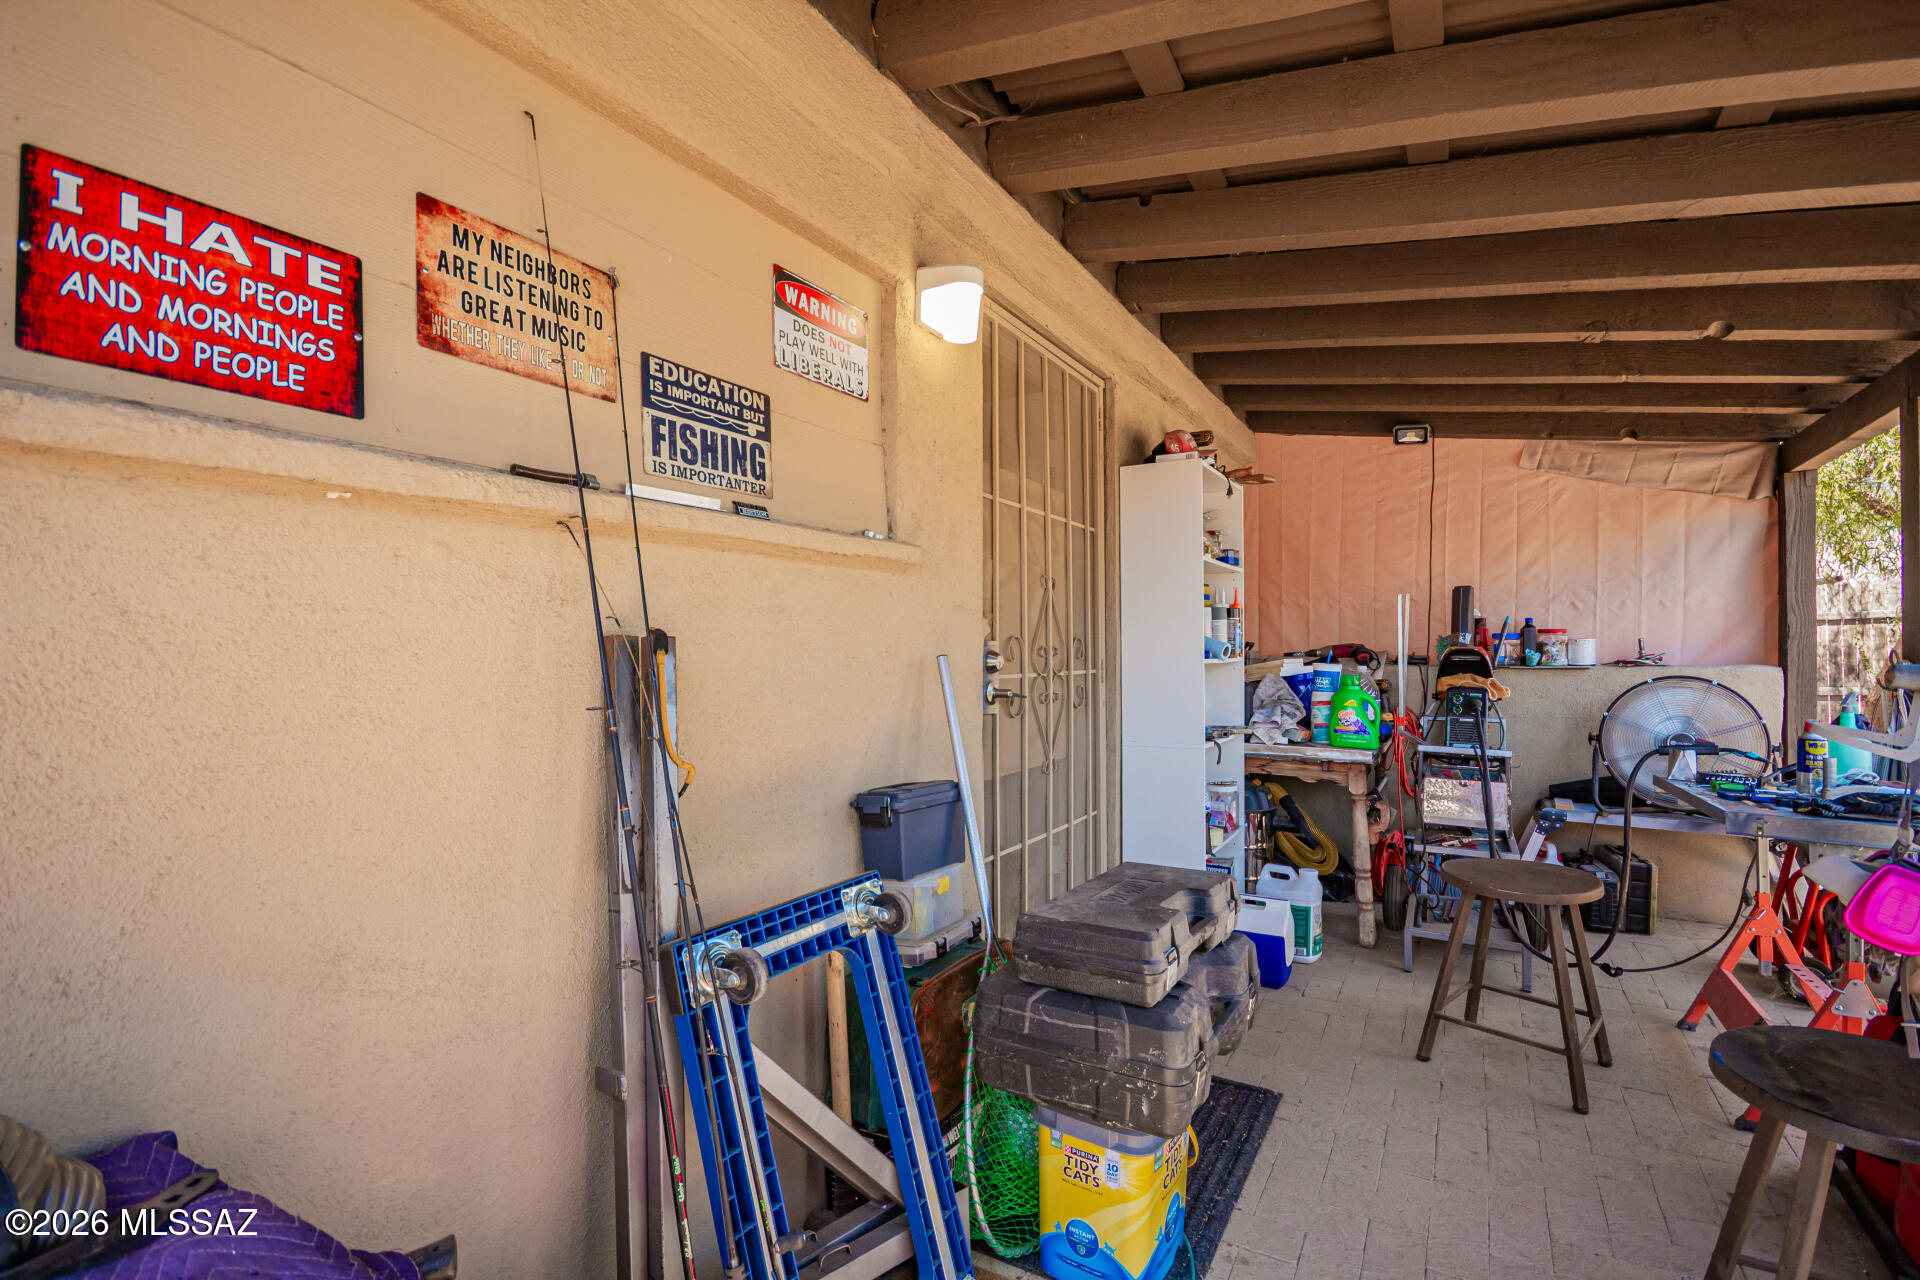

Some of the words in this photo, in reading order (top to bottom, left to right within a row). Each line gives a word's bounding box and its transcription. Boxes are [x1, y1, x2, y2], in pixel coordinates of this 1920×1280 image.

[50, 168, 84, 215] I
[120, 191, 343, 295] HATE
[46, 220, 228, 297] MORNING
[239, 277, 345, 331] PEOPLE
[452, 223, 484, 256] MY
[490, 238, 592, 300] NEIGHBORS
[437, 249, 479, 286] ARE
[484, 266, 580, 322] LISTENING
[584, 305, 603, 331] TO
[784, 283, 857, 335] WARNING
[59, 270, 143, 314] AND
[157, 293, 336, 362] MORNINGS
[461, 290, 527, 333] GREAT
[531, 314, 586, 353] MUSIC
[793, 319, 825, 343] DOES
[829, 335, 851, 355] NOT
[100, 322, 181, 363] AND
[193, 341, 306, 392] PEOPLE
[431, 312, 491, 352] WHETHER
[496, 333, 525, 361] THEY
[530, 344, 553, 371] LIKE
[572, 359, 585, 379] OR
[588, 364, 607, 388] NOT
[779, 329, 806, 348] PLAY
[809, 343, 837, 366] WELL
[840, 356, 864, 377] WITH
[779, 346, 864, 398] LIBERALS
[649, 356, 765, 412] EDUCATION
[649, 378, 663, 393] IS
[667, 384, 740, 417] IMPORTANT
[743, 408, 765, 425] BUT
[651, 414, 767, 482] FISHING
[652, 460, 668, 475] IS
[671, 464, 767, 496] IMPORTANTER
[1338, 710, 1355, 718] Gain
[1063, 1166, 1100, 1188] CATS
[1064, 1154, 1099, 1175] TIDY
[1071, 1147, 1099, 1162] PURINA
[1106, 1163, 1119, 1173] 10
[1163, 1154, 1182, 1190] CATS
[1165, 1143, 1182, 1172] TIDY
[1068, 1225, 1096, 1240] INSTANT
